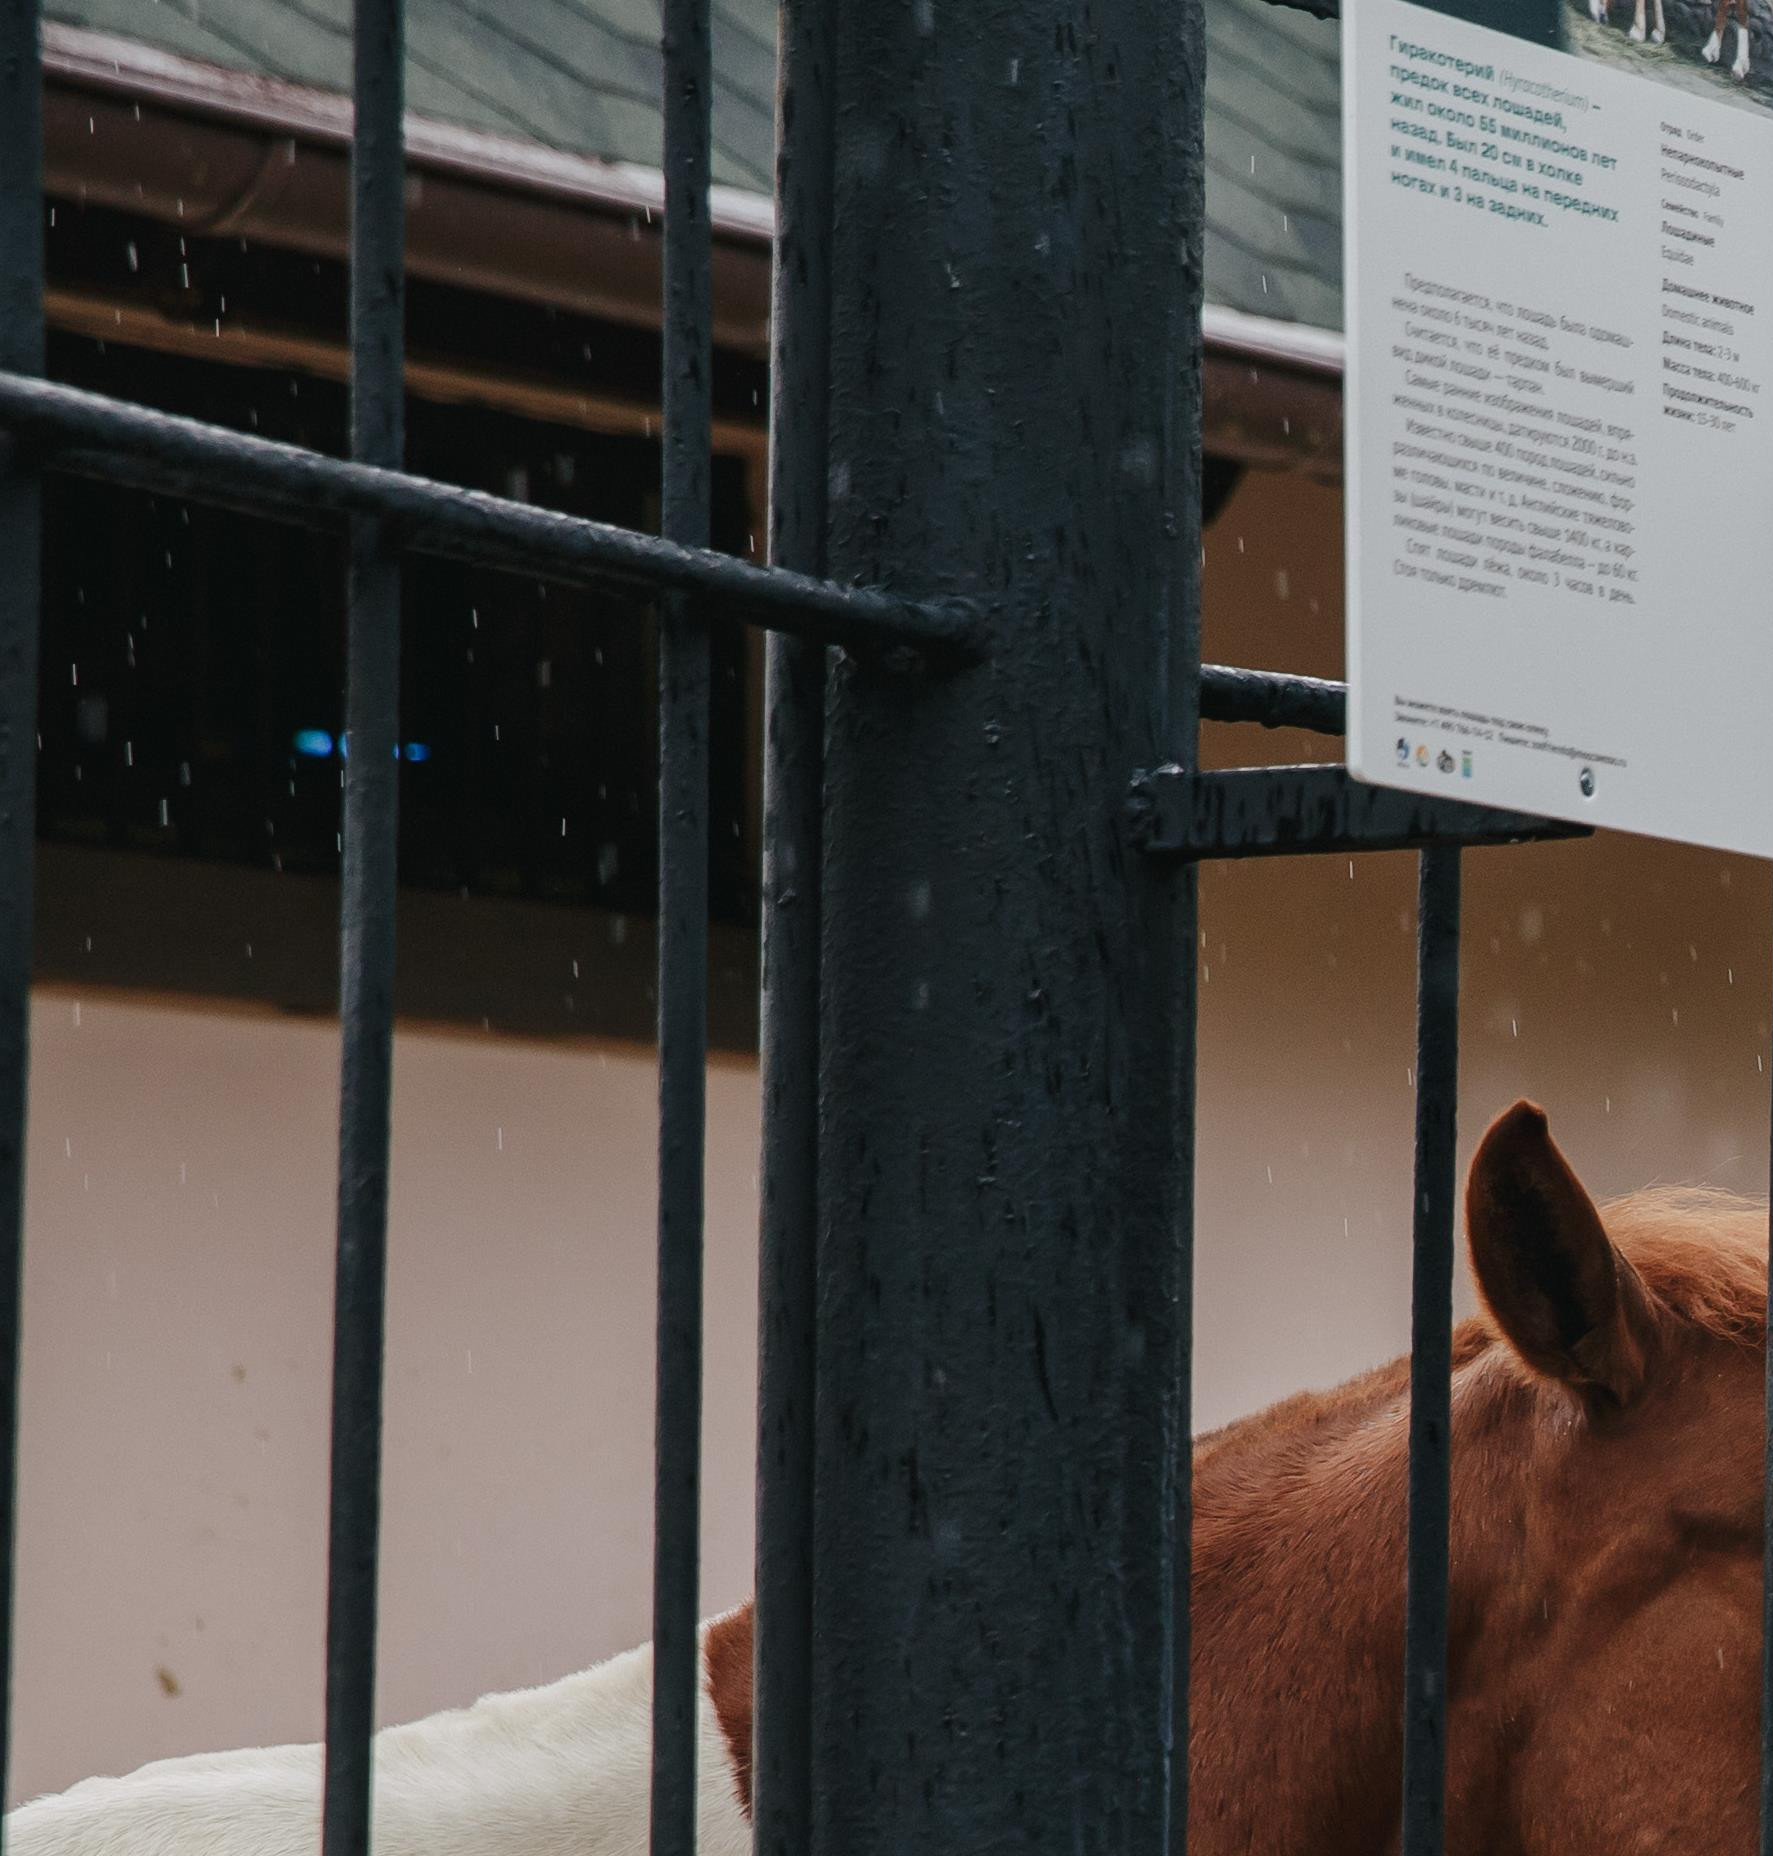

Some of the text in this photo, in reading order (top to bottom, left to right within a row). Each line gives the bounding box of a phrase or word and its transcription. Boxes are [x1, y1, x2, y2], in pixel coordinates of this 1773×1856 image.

[1390, 34, 1494, 81] Гиракотерий
[1390, 65, 1566, 133] предок всех лошадей,
[1390, 91, 1618, 170] жил около 55 миллионов лет
[1391, 118, 1441, 145] назад.
[1446, 131, 1477, 154] Был
[1481, 142, 1498, 161] 20
[1502, 151, 1522, 168] см
[1538, 162, 1583, 186] холке
[1661, 144, 1744, 180] Непарнокопытные
[1391, 172, 1435, 194] ногах
[1466, 194, 1485, 209] на
[1488, 199, 1548, 227] задних.
[1405, 149, 1446, 171] имел
[1462, 166, 1518, 193] пальца
[1522, 184, 1540, 199] на
[1544, 190, 1618, 222] передних
[1661, 278, 1754, 315] Домашнее животное
[1662, 330, 1692, 350] Длина
[1464, 341, 1483, 356] что
[1554, 360, 1575, 379] был
[1663, 357, 1691, 376] Масса
[1663, 383, 1754, 418] Продолжительность
[1481, 463, 1495, 477] по
[1456, 505, 1487, 525] могут
